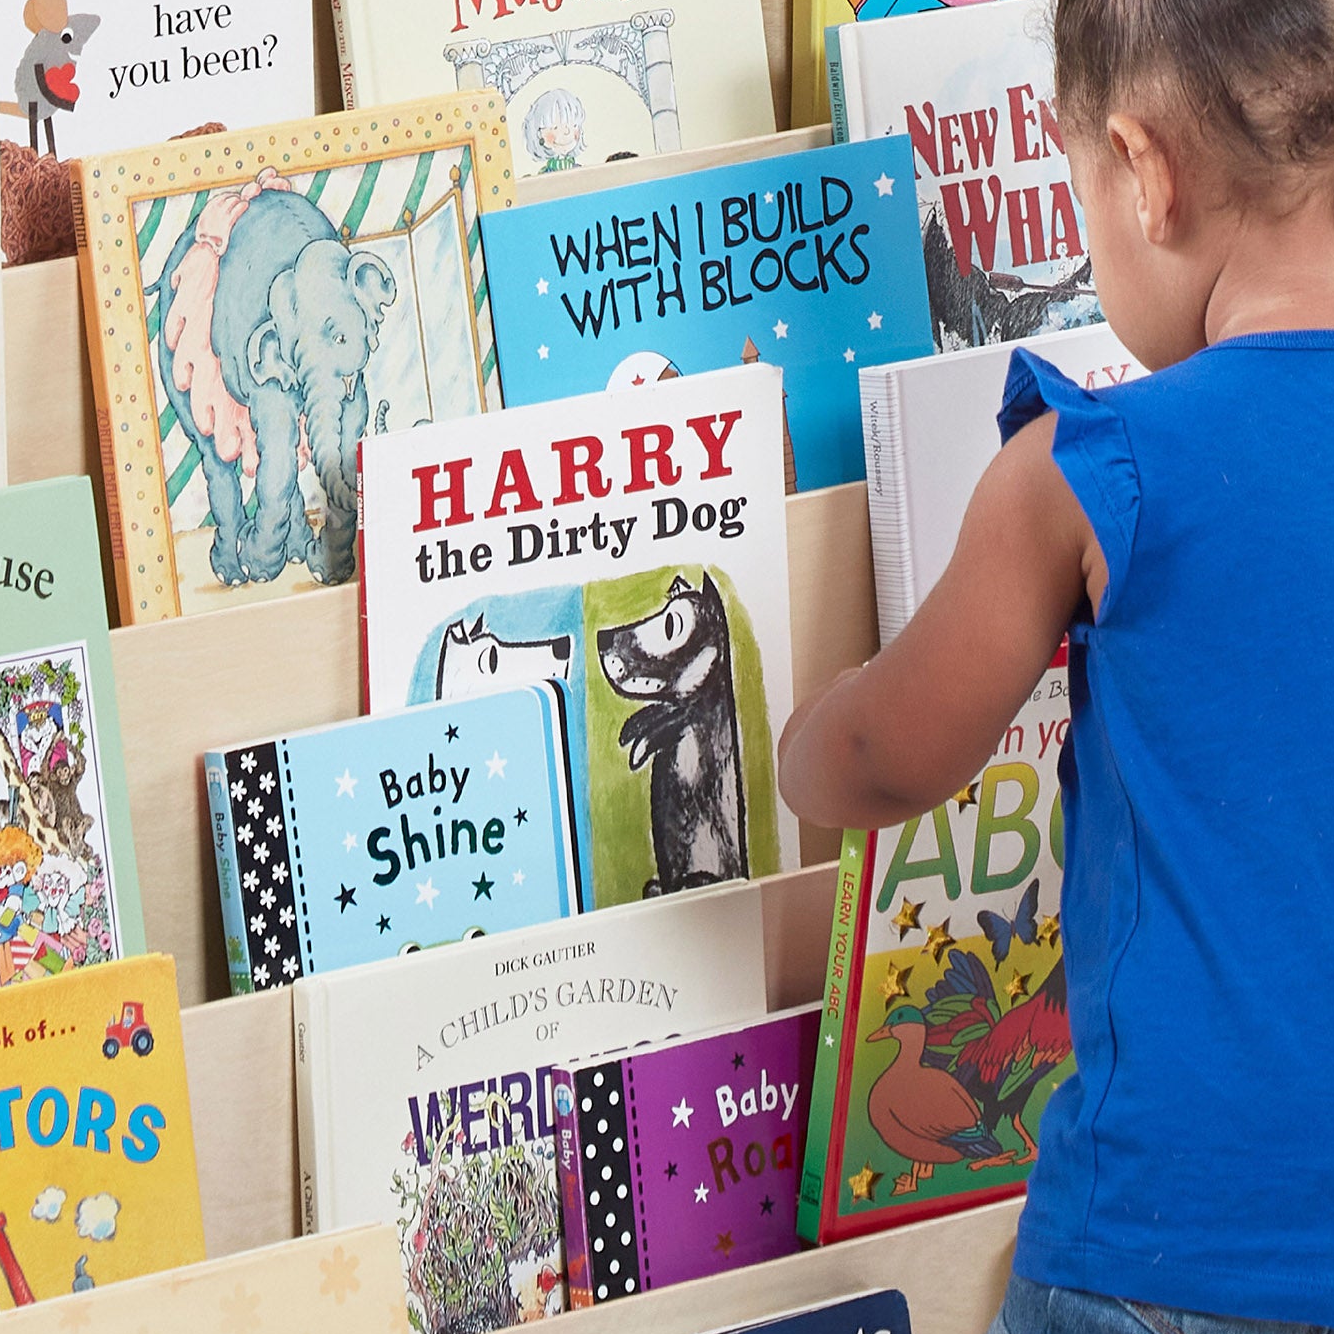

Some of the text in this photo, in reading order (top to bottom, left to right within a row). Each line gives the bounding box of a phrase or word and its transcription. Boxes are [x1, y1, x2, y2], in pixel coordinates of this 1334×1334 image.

[153, 2, 232, 38] have
[109, 33, 279, 99] you been?
[903, 101, 998, 180] NEW
[550, 176, 854, 277] WHEN I BUILD
[560, 223, 871, 340] WITH BLOCKS
[411, 409, 743, 534] HARRY
[415, 493, 748, 584] the Dirty Dog
[379, 752, 470, 809] Baby
[214, 811, 228, 852] Baby
[366, 805, 506, 887] Shine
[875, 761, 1064, 914] AB
[219, 857, 231, 901] Shine
[495, 941, 596, 977] DICK GAUTIER
[826, 871, 856, 1019] LEARN YOUR ABC
[416, 1044, 435, 1072] A
[439, 987, 548, 1049] CHILD'S
[555, 978, 679, 1012] GARDEN
[535, 1021, 560, 1042] OF
[715, 1069, 799, 1128] Baby
[560, 1128, 575, 1172] Baby
